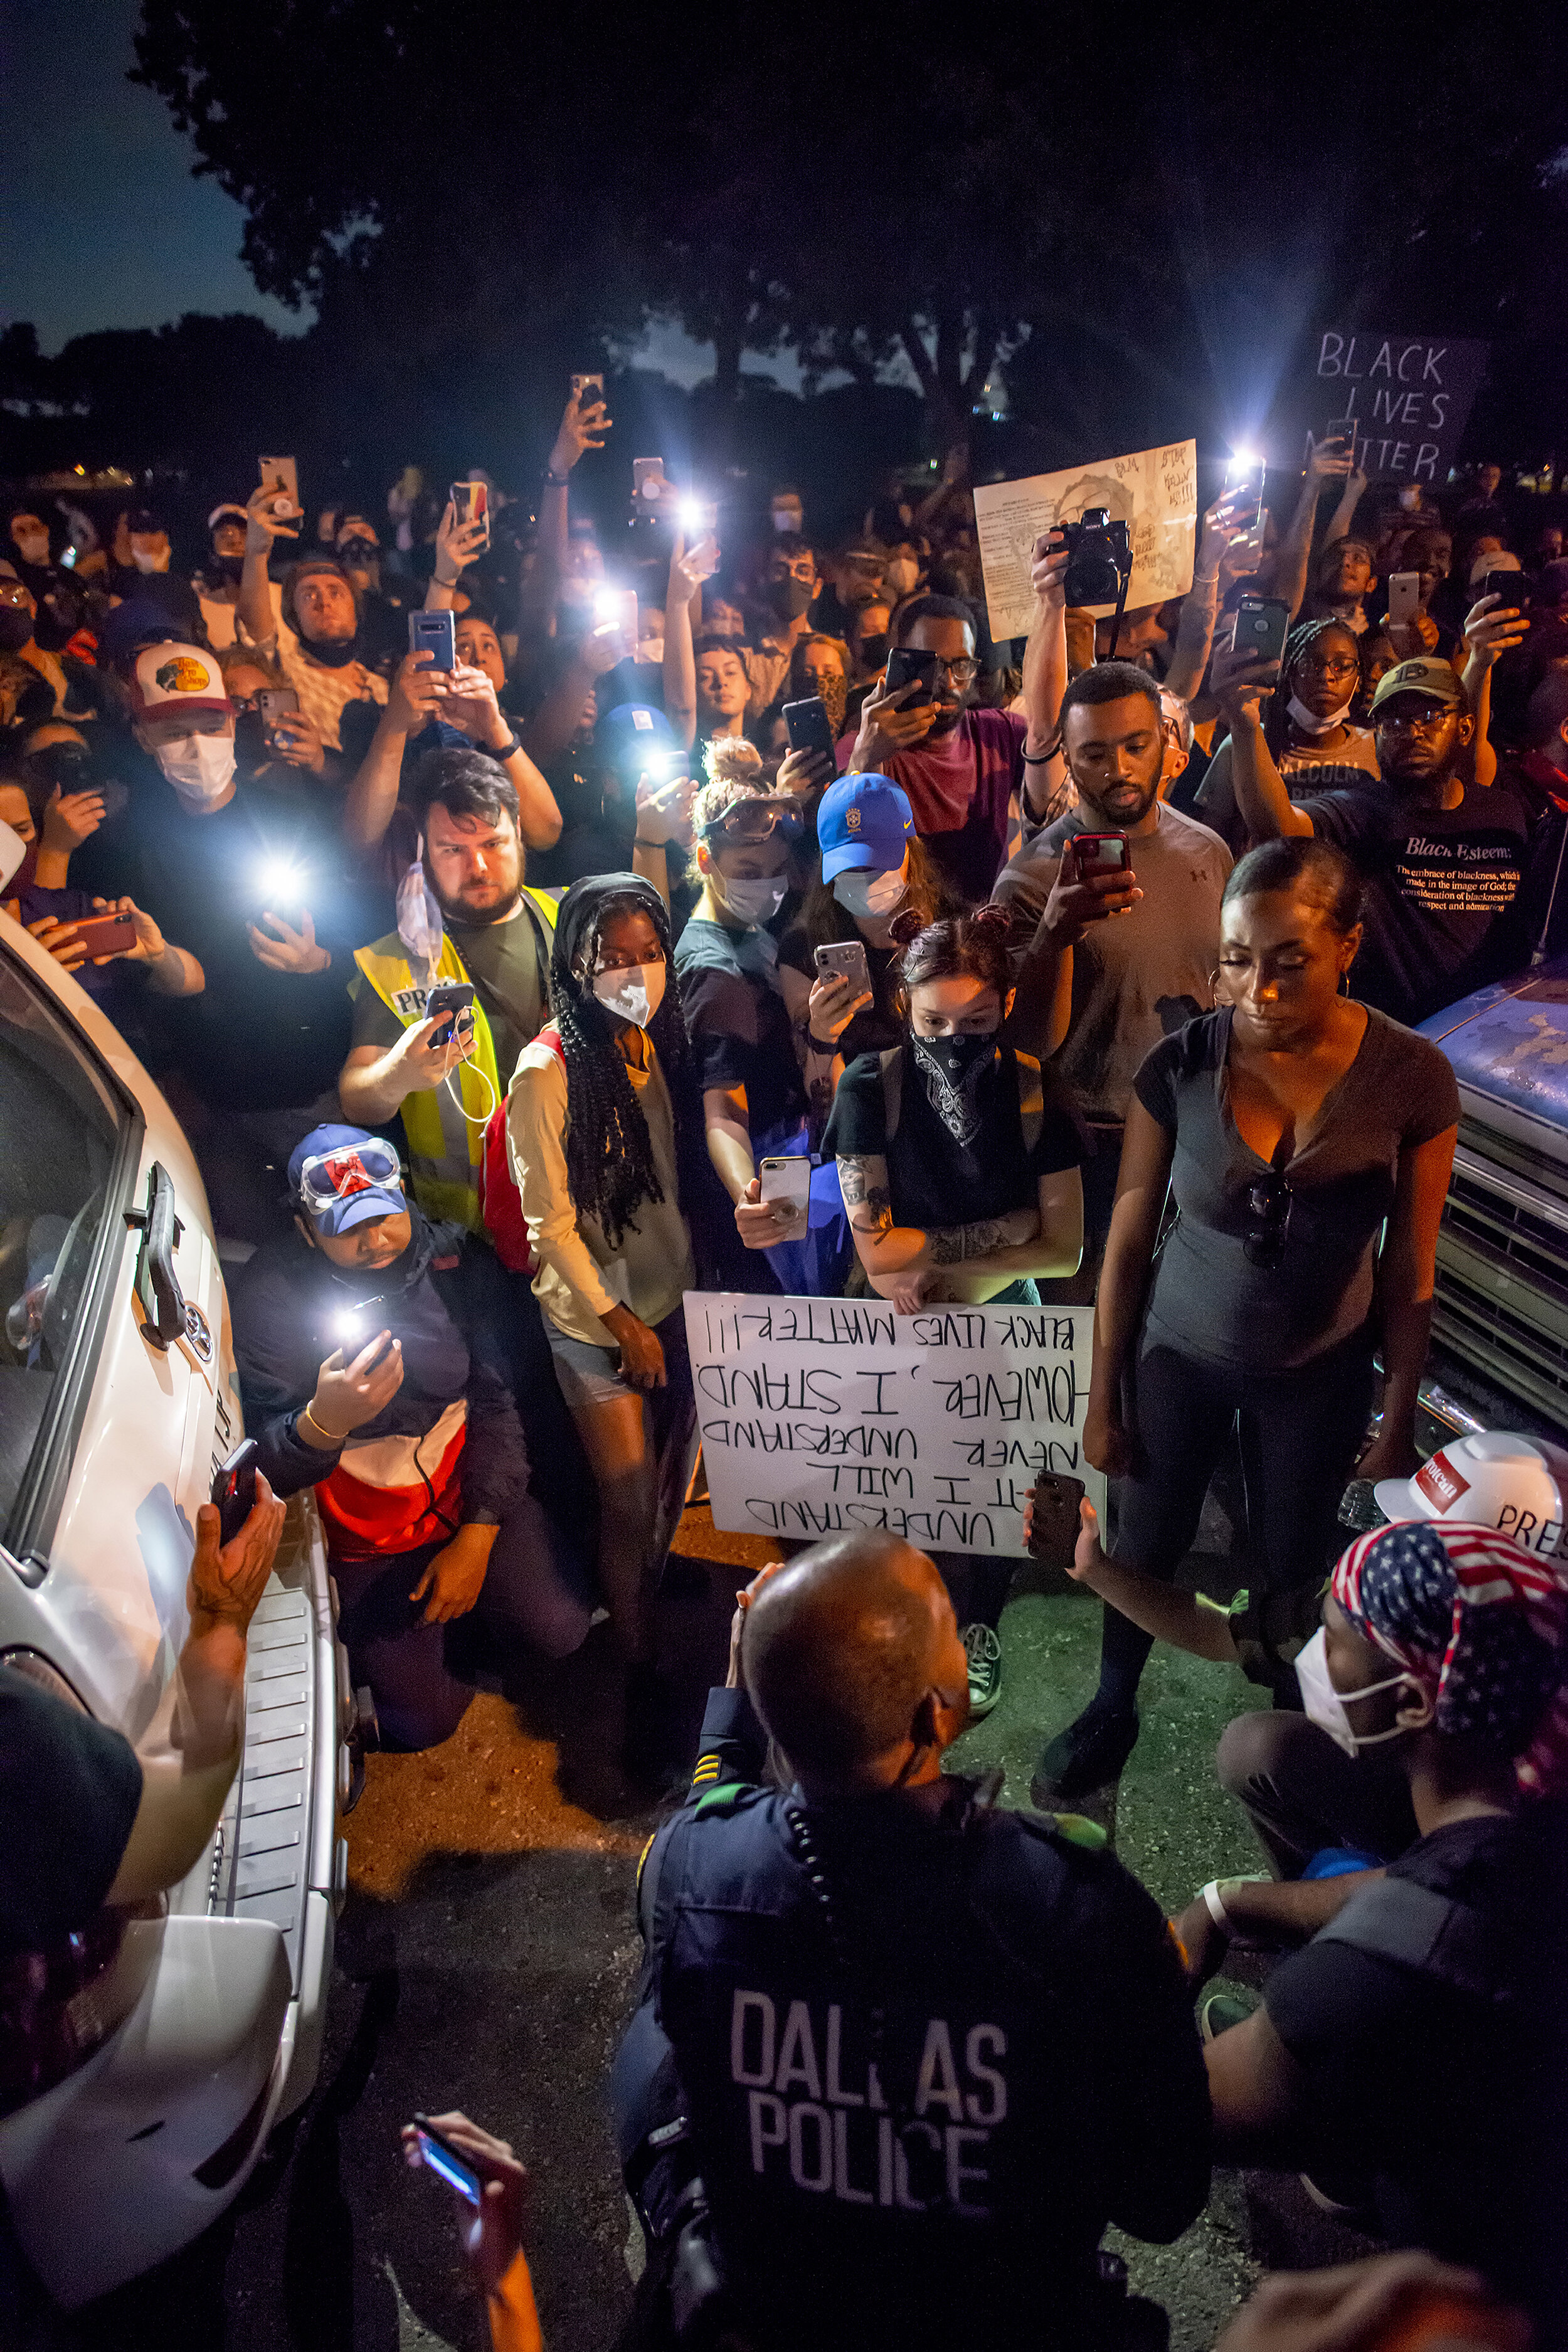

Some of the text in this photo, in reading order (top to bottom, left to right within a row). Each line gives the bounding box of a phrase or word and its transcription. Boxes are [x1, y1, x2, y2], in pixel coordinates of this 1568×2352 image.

[1316, 332, 1447, 385] BLACK
[1457, 844, 1512, 861] Esteem:
[1396, 865, 1410, 874] The
[1411, 869, 1445, 879] embrace
[1446, 871, 1457, 879] of
[1458, 871, 1499, 881] blackness,
[1500, 872, 1517, 880] which
[1406, 878, 1516, 892] made in the image of God; the
[1401, 889, 1455, 900] consideration
[1456, 891, 1465, 900] of
[1466, 892, 1504, 901] blackness
[1418, 901, 1505, 912] respect and admiration
[704, 1304, 1075, 1353] BLACK LIVES MATTER!!!
[857, 1371, 898, 1415] I
[702, 1419, 1079, 1470] NEVER UNDERSTAND
[806, 1462, 914, 1499] WILL
[934, 1476, 970, 1506] I
[746, 1498, 995, 1548] UNDERSTAND
[749, 2090, 992, 2218] POLICE
